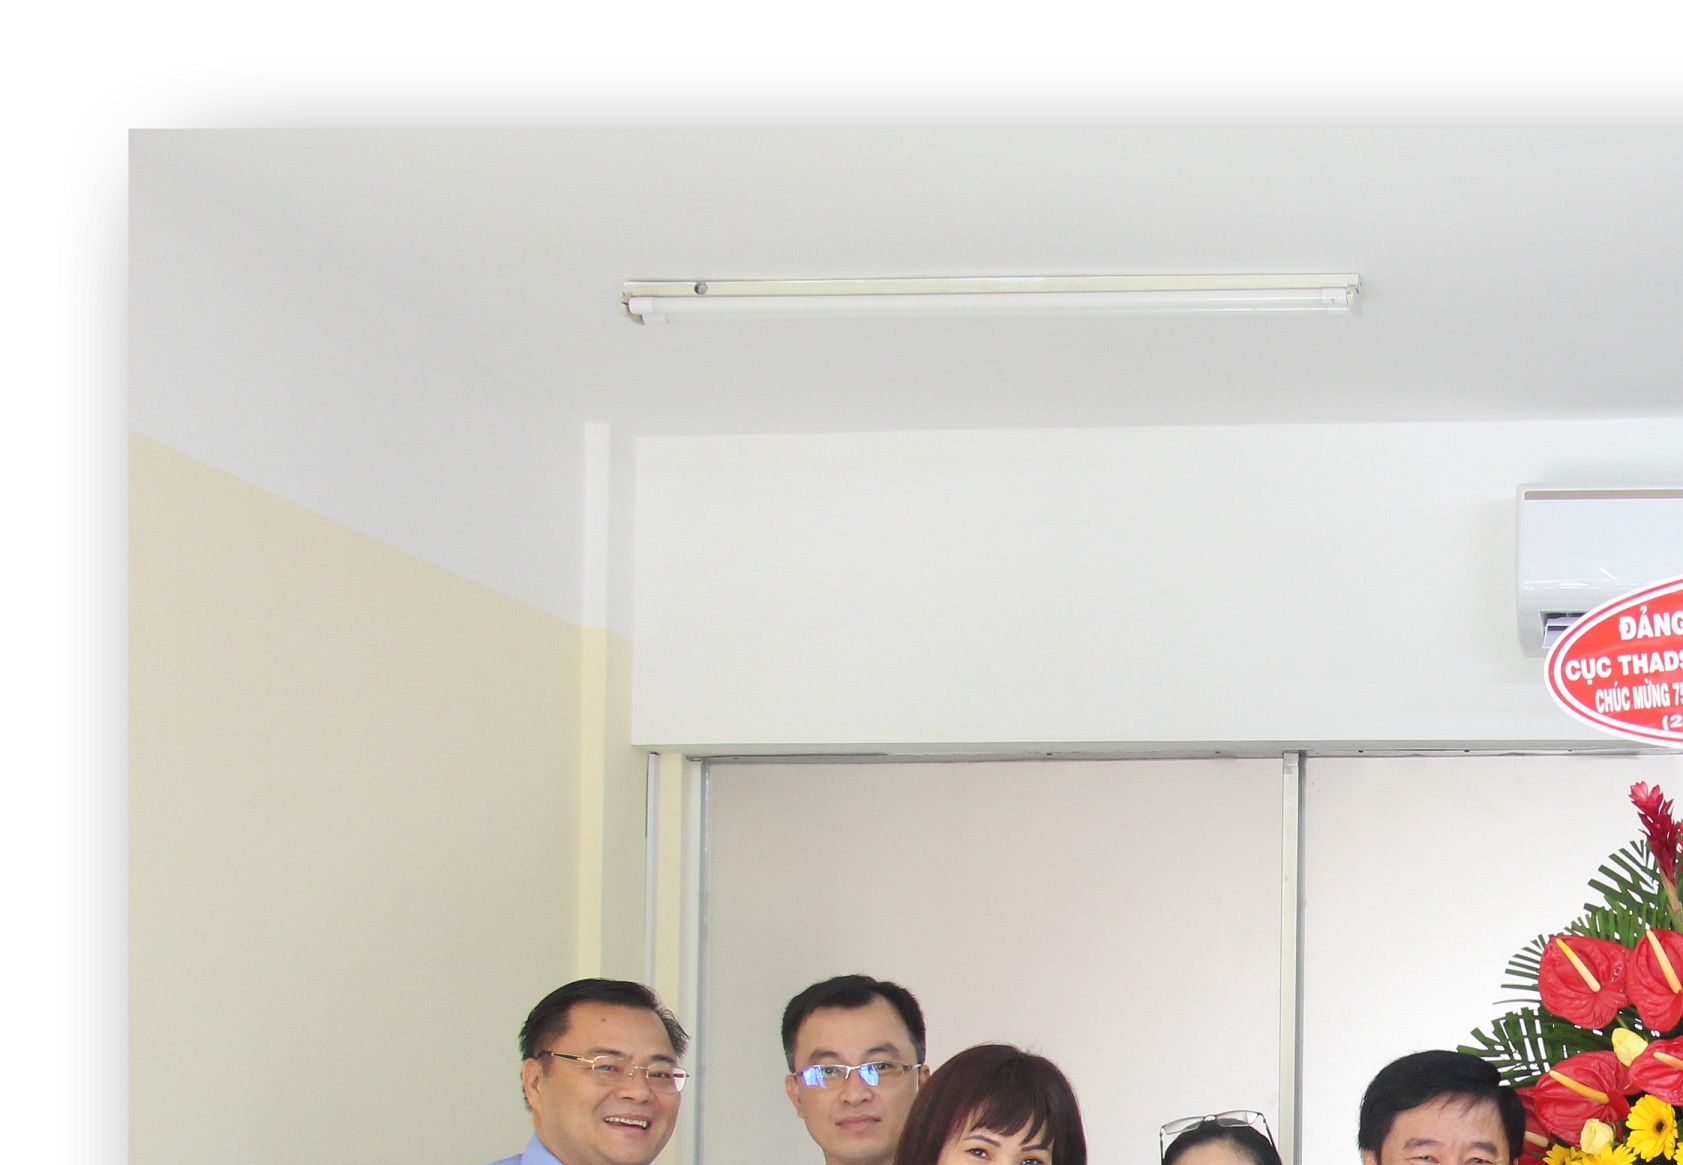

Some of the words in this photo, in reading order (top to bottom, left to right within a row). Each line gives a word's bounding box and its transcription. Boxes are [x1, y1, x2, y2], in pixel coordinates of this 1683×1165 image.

[1564, 656, 1612, 685] CỤC
[1595, 681, 1631, 714] CHÚC
[1632, 678, 1671, 710] MỪNG
